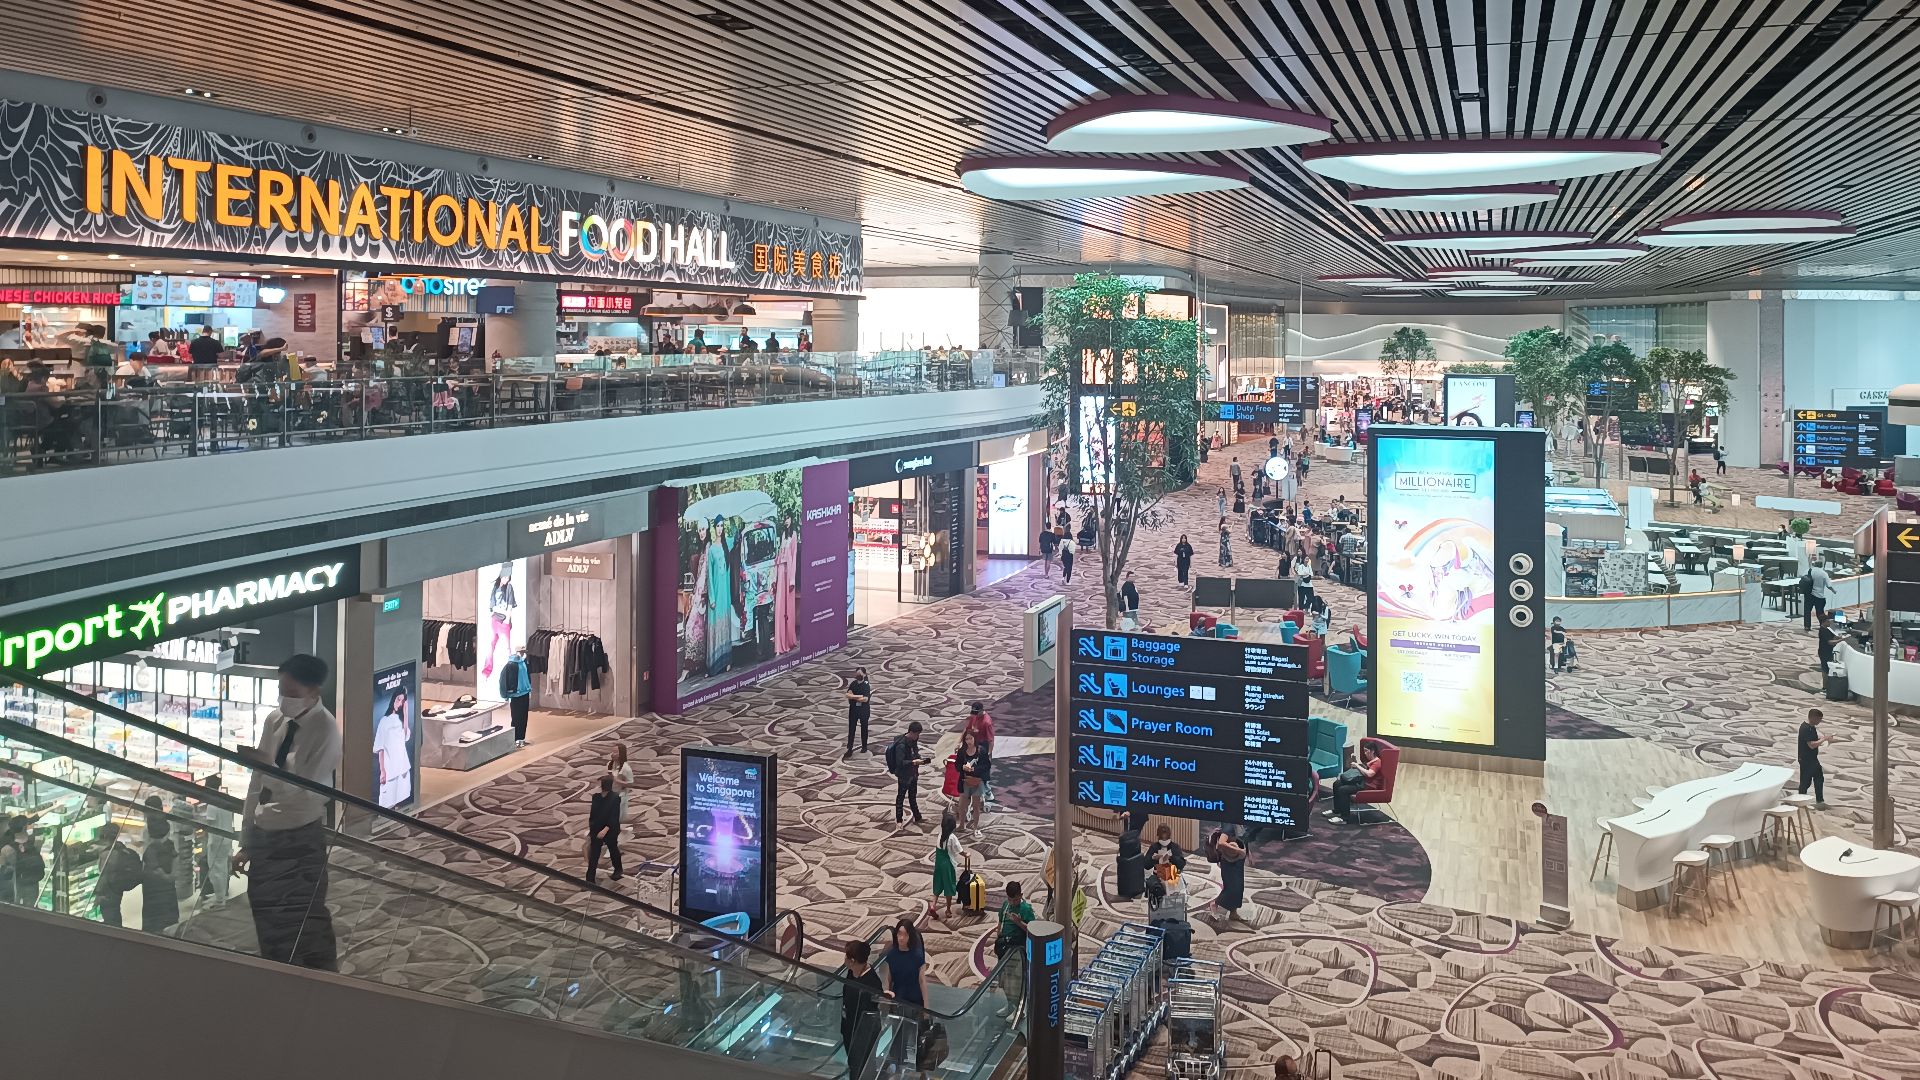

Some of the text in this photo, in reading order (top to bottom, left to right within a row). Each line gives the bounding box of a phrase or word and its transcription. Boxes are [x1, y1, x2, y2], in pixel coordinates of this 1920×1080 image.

[85, 145, 735, 269] INTERNATIONAL FOOD HALL
[753, 243, 842, 280] 国际美食坊
[33, 290, 89, 304] CHICKEN
[92, 292, 120, 305] RICE
[1859, 391, 1889, 400] GASSA
[1236, 404, 1272, 413] Duty Free
[1236, 413, 1255, 421] Shop
[1399, 477, 1471, 489] MILLIONAIRE
[806, 504, 842, 521] KASHKHA
[544, 527, 575, 546] ADLV
[567, 564, 589, 573] ADLV
[0, 562, 344, 669] rport PHARMACY
[186, 639, 222, 664] CARE
[1131, 638, 1181, 653] Baggage
[1131, 652, 1175, 666] Storage
[1131, 681, 1185, 697] Lounges
[1131, 718, 1213, 736] Prayer Room
[1131, 754, 1196, 772] 24hr Food
[699, 772, 740, 786] Welcome
[696, 782, 755, 799] to Singapore!
[1131, 790, 1225, 811] 24hr Minimart
[1048, 969, 1060, 1027] Trolleys
